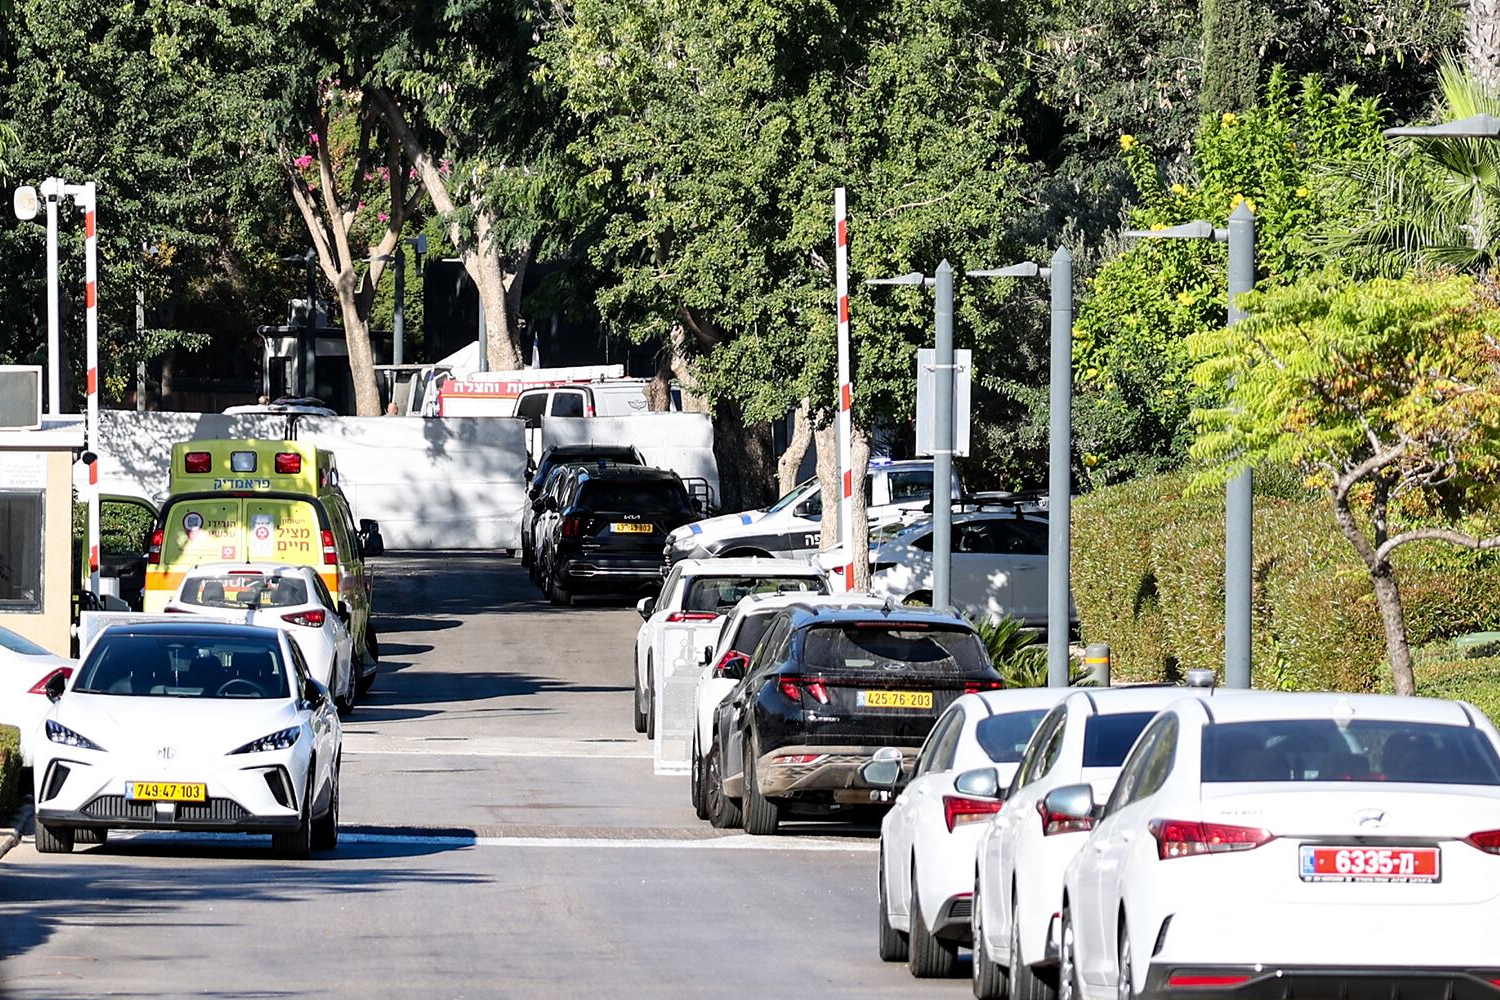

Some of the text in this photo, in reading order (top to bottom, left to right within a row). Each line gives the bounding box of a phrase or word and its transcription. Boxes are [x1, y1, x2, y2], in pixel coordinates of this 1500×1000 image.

[453, 381, 499, 393] והצלה
[214, 479, 270, 490] פראמדיק
[277, 526, 311, 539] מציל
[277, 541, 310, 551] חיים
